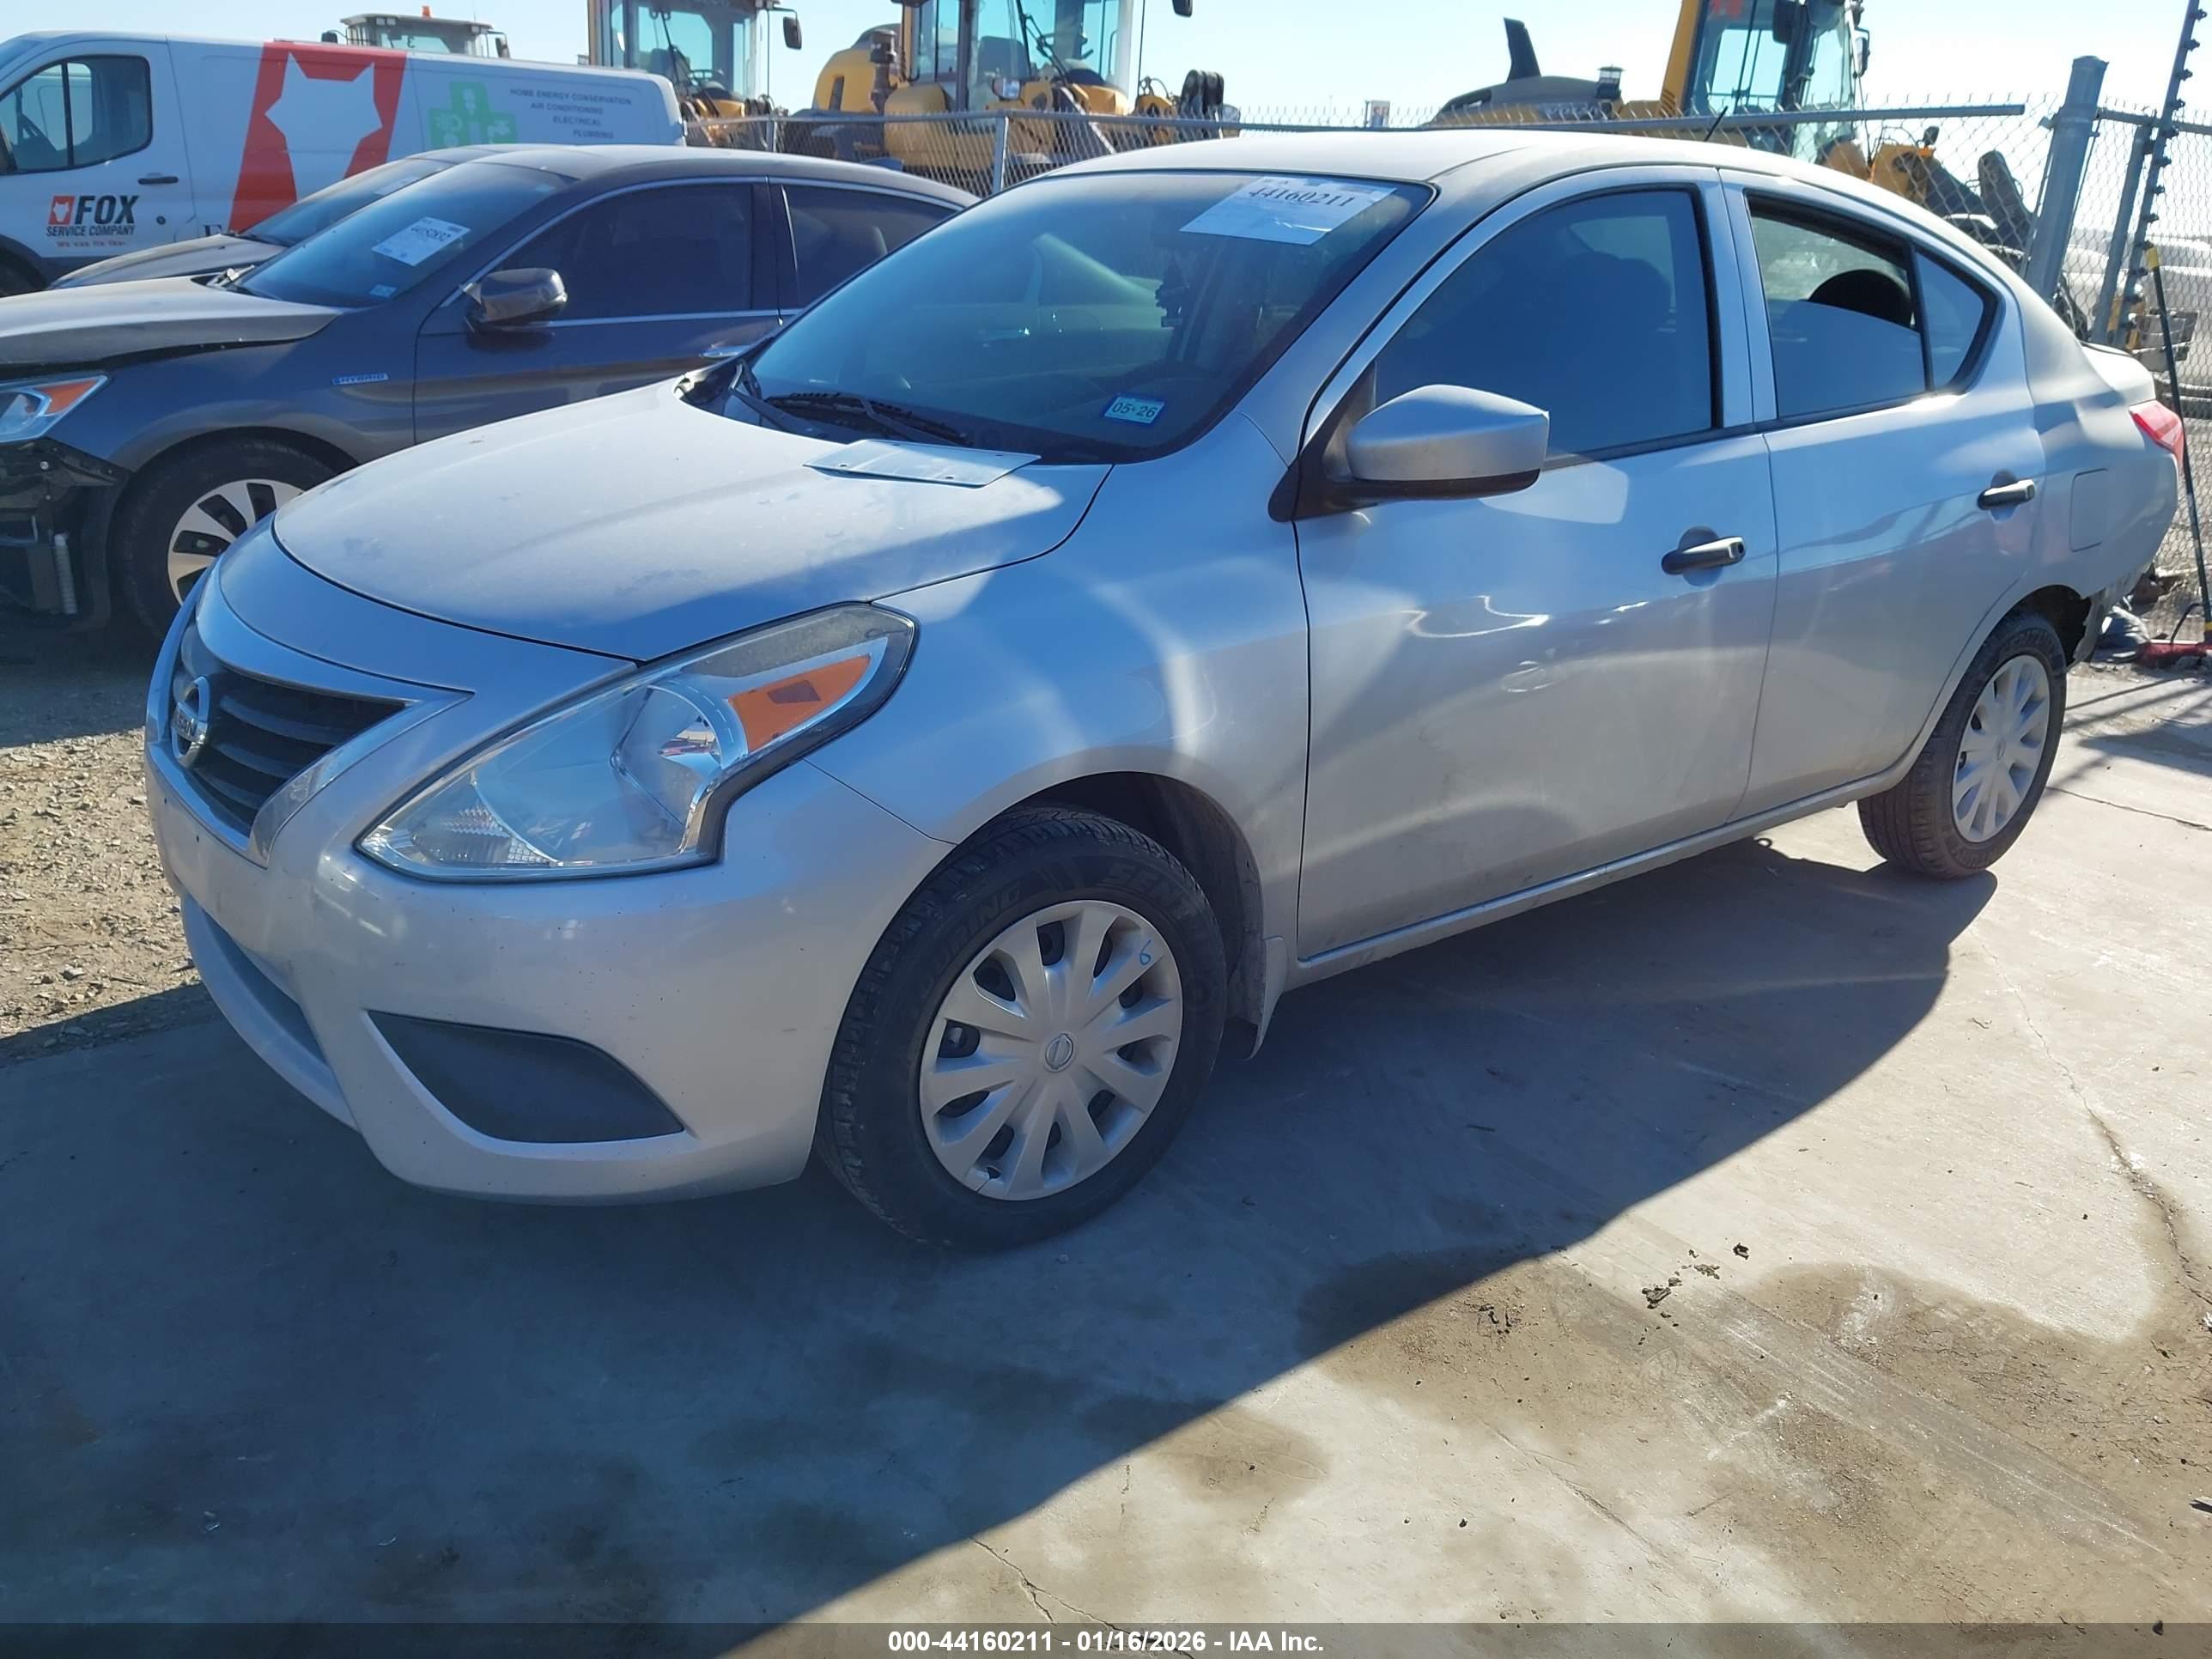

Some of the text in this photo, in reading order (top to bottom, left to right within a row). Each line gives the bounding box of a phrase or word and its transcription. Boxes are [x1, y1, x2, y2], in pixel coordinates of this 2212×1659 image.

[510, 88, 632, 105] HOME ENERGY CONSERVATION
[530, 102, 604, 114] AIR CONDITIONING
[553, 116, 601, 126] ELECTRICAL
[1248, 186, 1357, 207] 44160211
[75, 195, 139, 225] FOX
[46, 225, 136, 237] SERVICE COMPANY
[1140, 939, 1152, 965] 6
